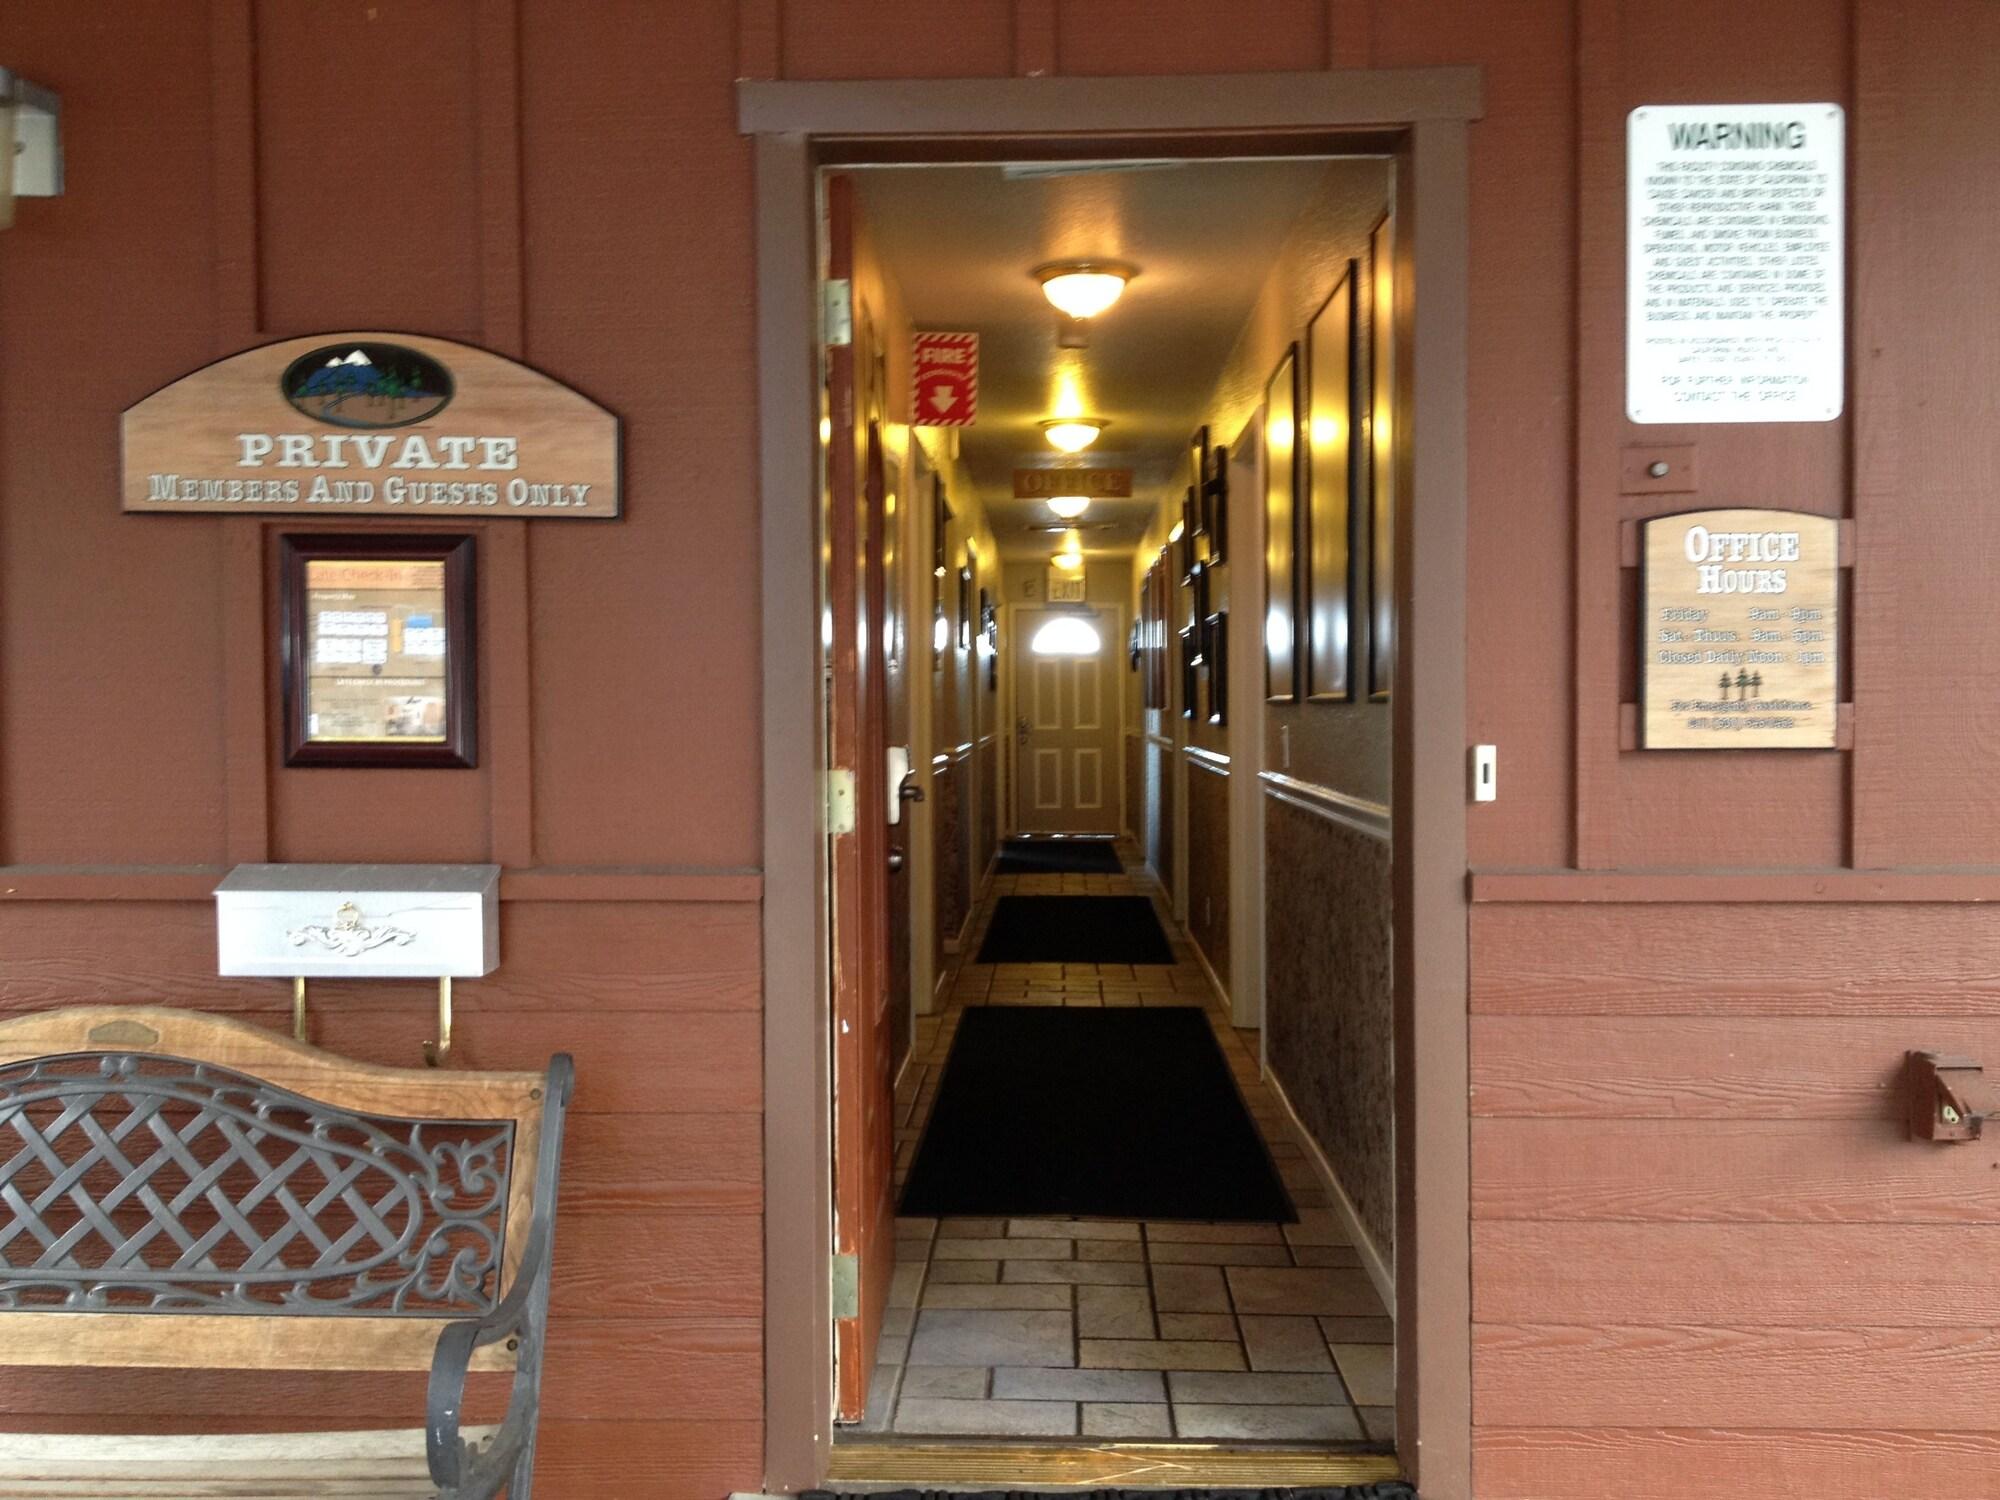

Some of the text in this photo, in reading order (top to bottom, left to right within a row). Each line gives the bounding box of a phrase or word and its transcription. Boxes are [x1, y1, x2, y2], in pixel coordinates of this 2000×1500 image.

[1668, 122, 1806, 150] WARNING
[922, 347, 965, 363] FIRE
[237, 433, 519, 471] PRIVATE
[148, 474, 590, 507] MEMBERS AND GUESTS ONLY
[1024, 472, 1121, 491] OFFICE
[1684, 525, 1799, 562] OFFICE
[1697, 564, 1787, 594] HOURS
[1661, 607, 1708, 622] Friday
[1659, 649, 1702, 664] Closed
[1705, 649, 1743, 666] Daily
